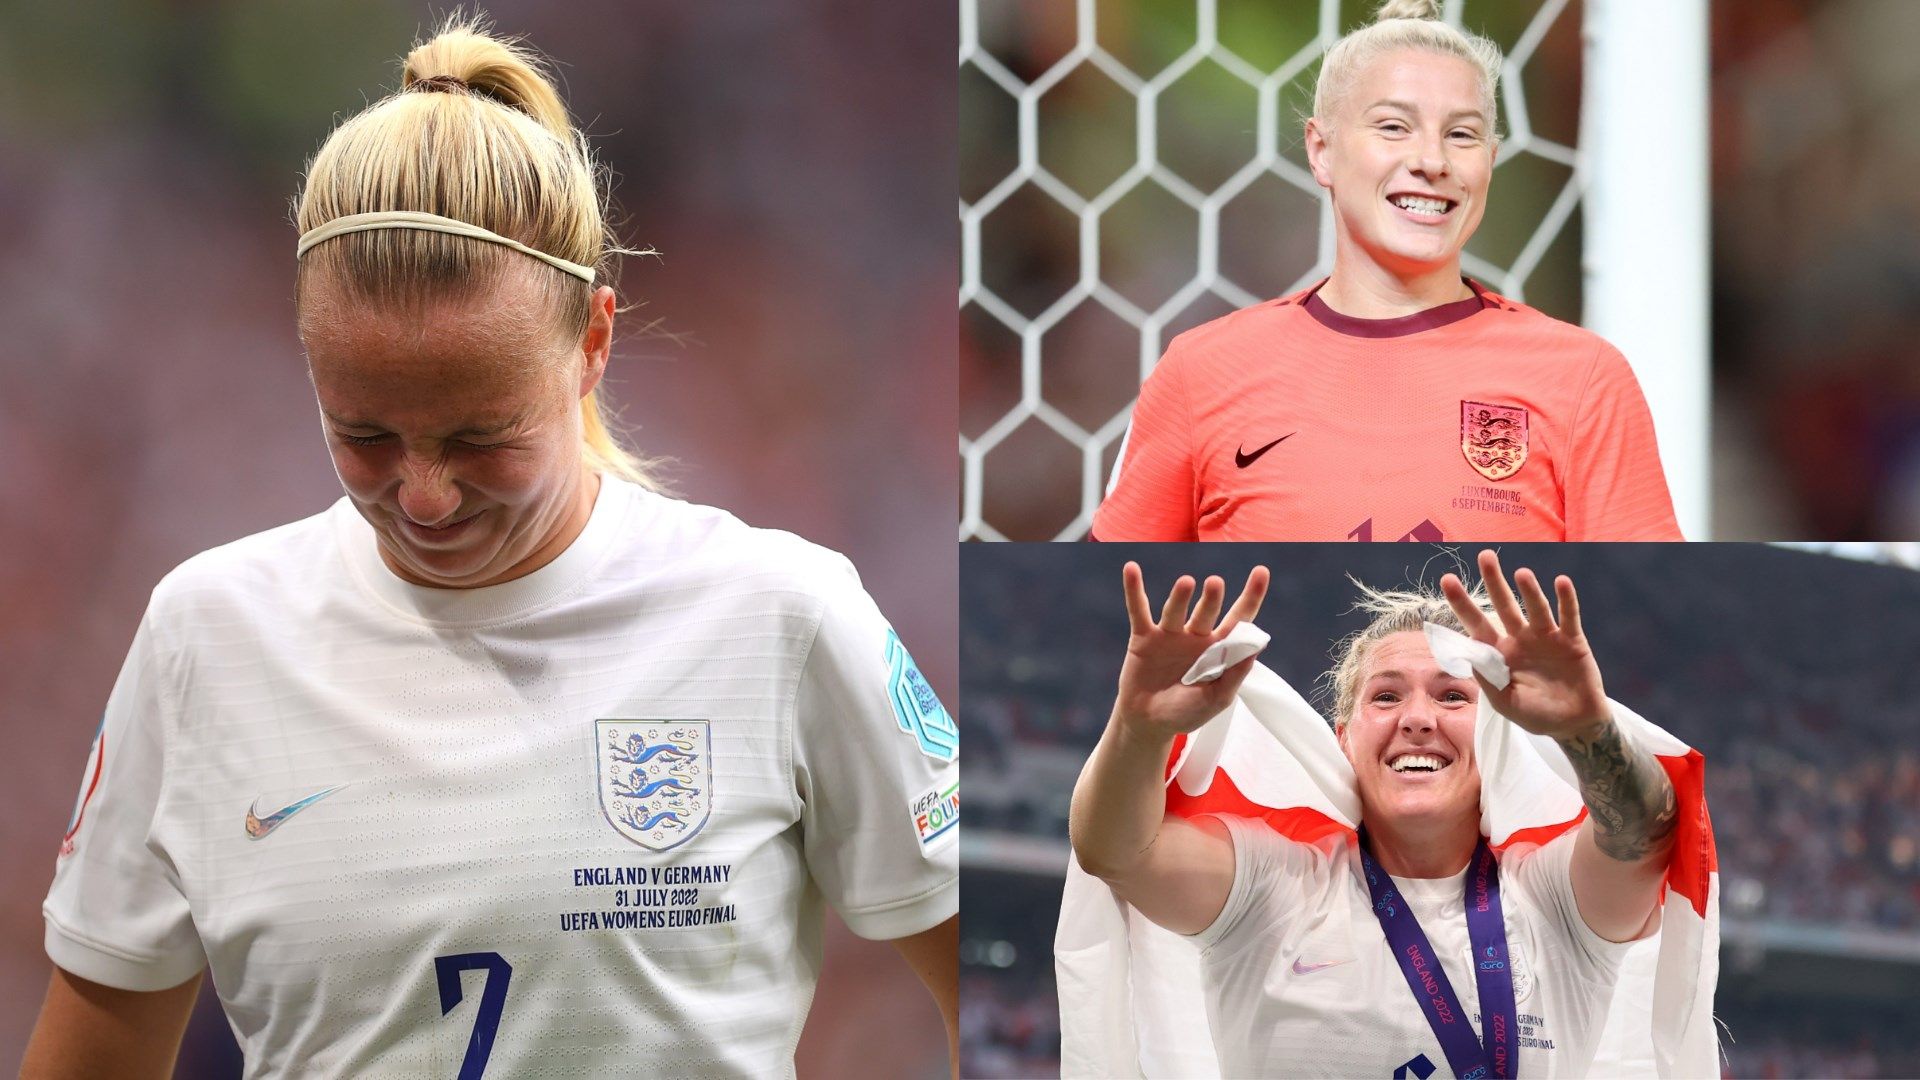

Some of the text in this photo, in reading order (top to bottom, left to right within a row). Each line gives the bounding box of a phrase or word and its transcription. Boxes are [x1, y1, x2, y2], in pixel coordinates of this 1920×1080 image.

[1452, 498, 1457, 508] 6
[1459, 498, 1510, 514] SEPTEMBER
[1462, 486, 1520, 502] LUXEMBOURG
[914, 791, 939, 815] UEFA
[574, 865, 731, 886] ENGLAND V GERMANY
[616, 888, 698, 907] 31 JULY 2022
[1476, 876, 1489, 912] ENGLAND
[560, 904, 737, 931] UEFA WOMENS EURO FINAL
[1407, 944, 1454, 1025] ENGLAND 2022
[434, 952, 513, 1080] 7
[1517, 1014, 1544, 1027] GERMAY
[1493, 1014, 1506, 1043] 2022
